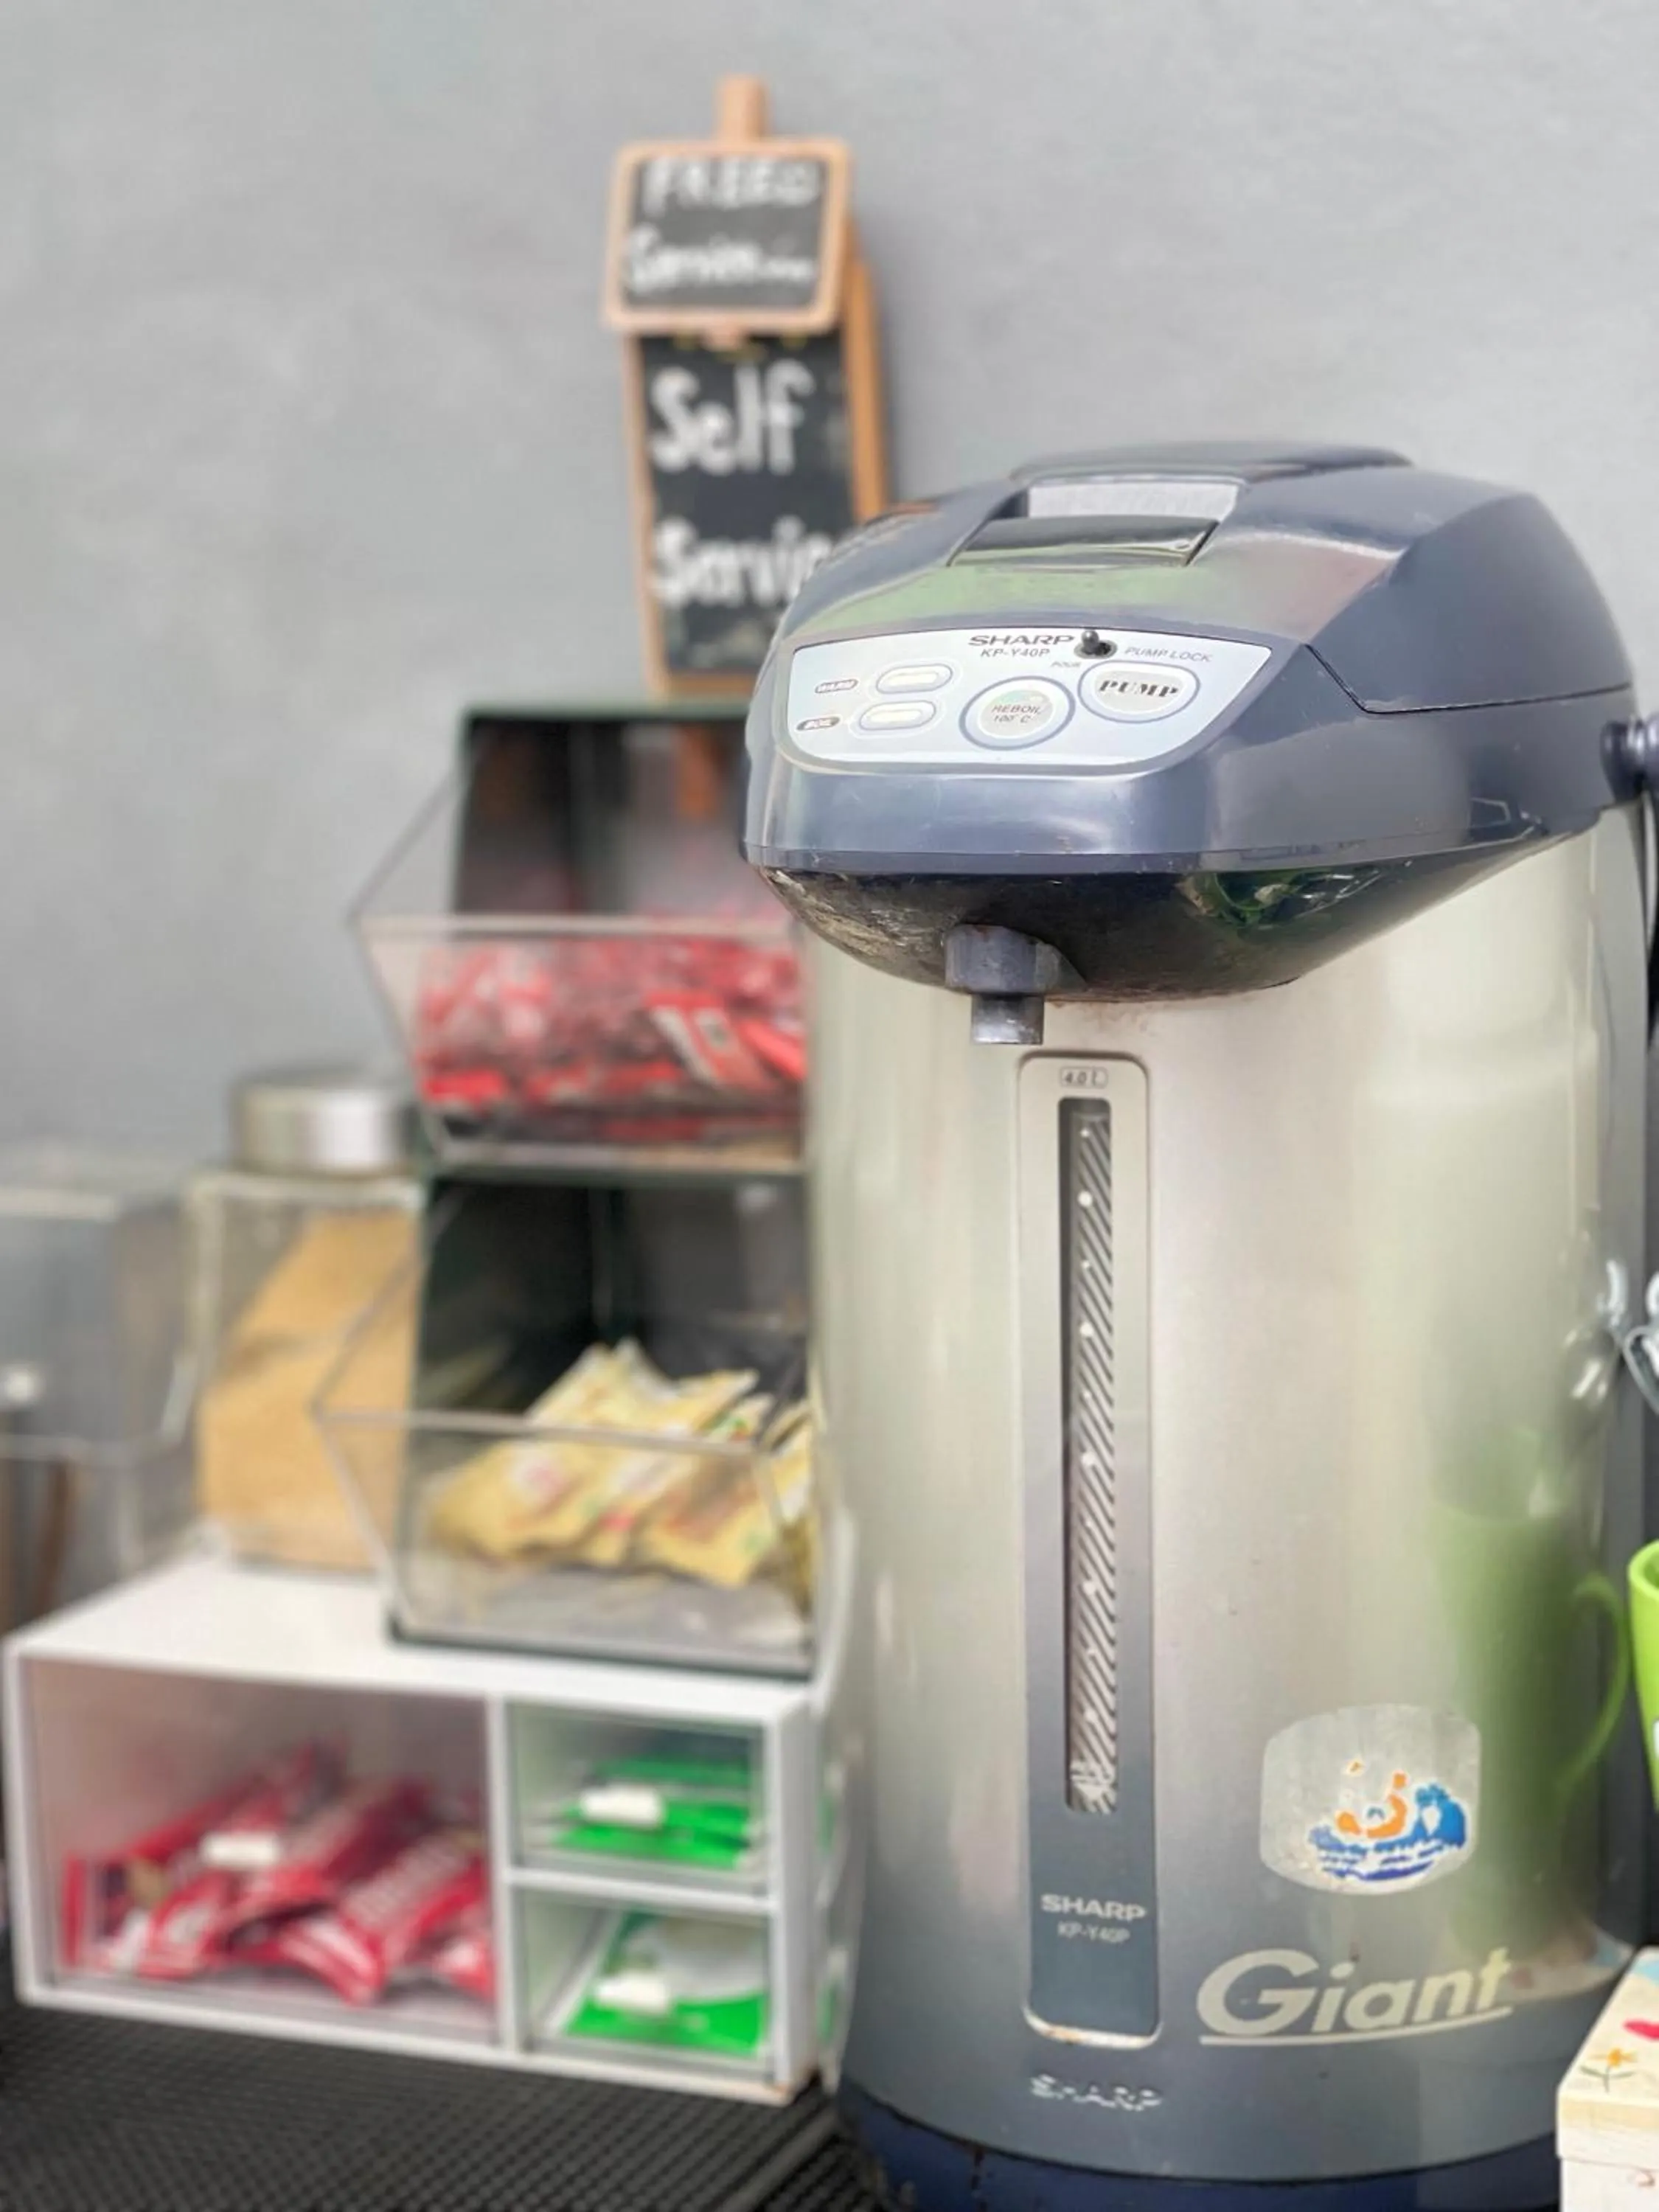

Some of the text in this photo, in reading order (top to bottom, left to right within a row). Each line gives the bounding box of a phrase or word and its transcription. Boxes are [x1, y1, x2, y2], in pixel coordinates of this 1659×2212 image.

[650, 358, 815, 476] Self
[649, 515, 833, 611] Servic
[968, 635, 1075, 647] SHARP
[981, 647, 1051, 658] KP-Y40P
[1124, 646, 1213, 662] PUMP LOCK
[1099, 679, 1179, 698] PUMP
[1040, 1893, 1147, 1922] SHARP
[1196, 1947, 1512, 2037] Giant
